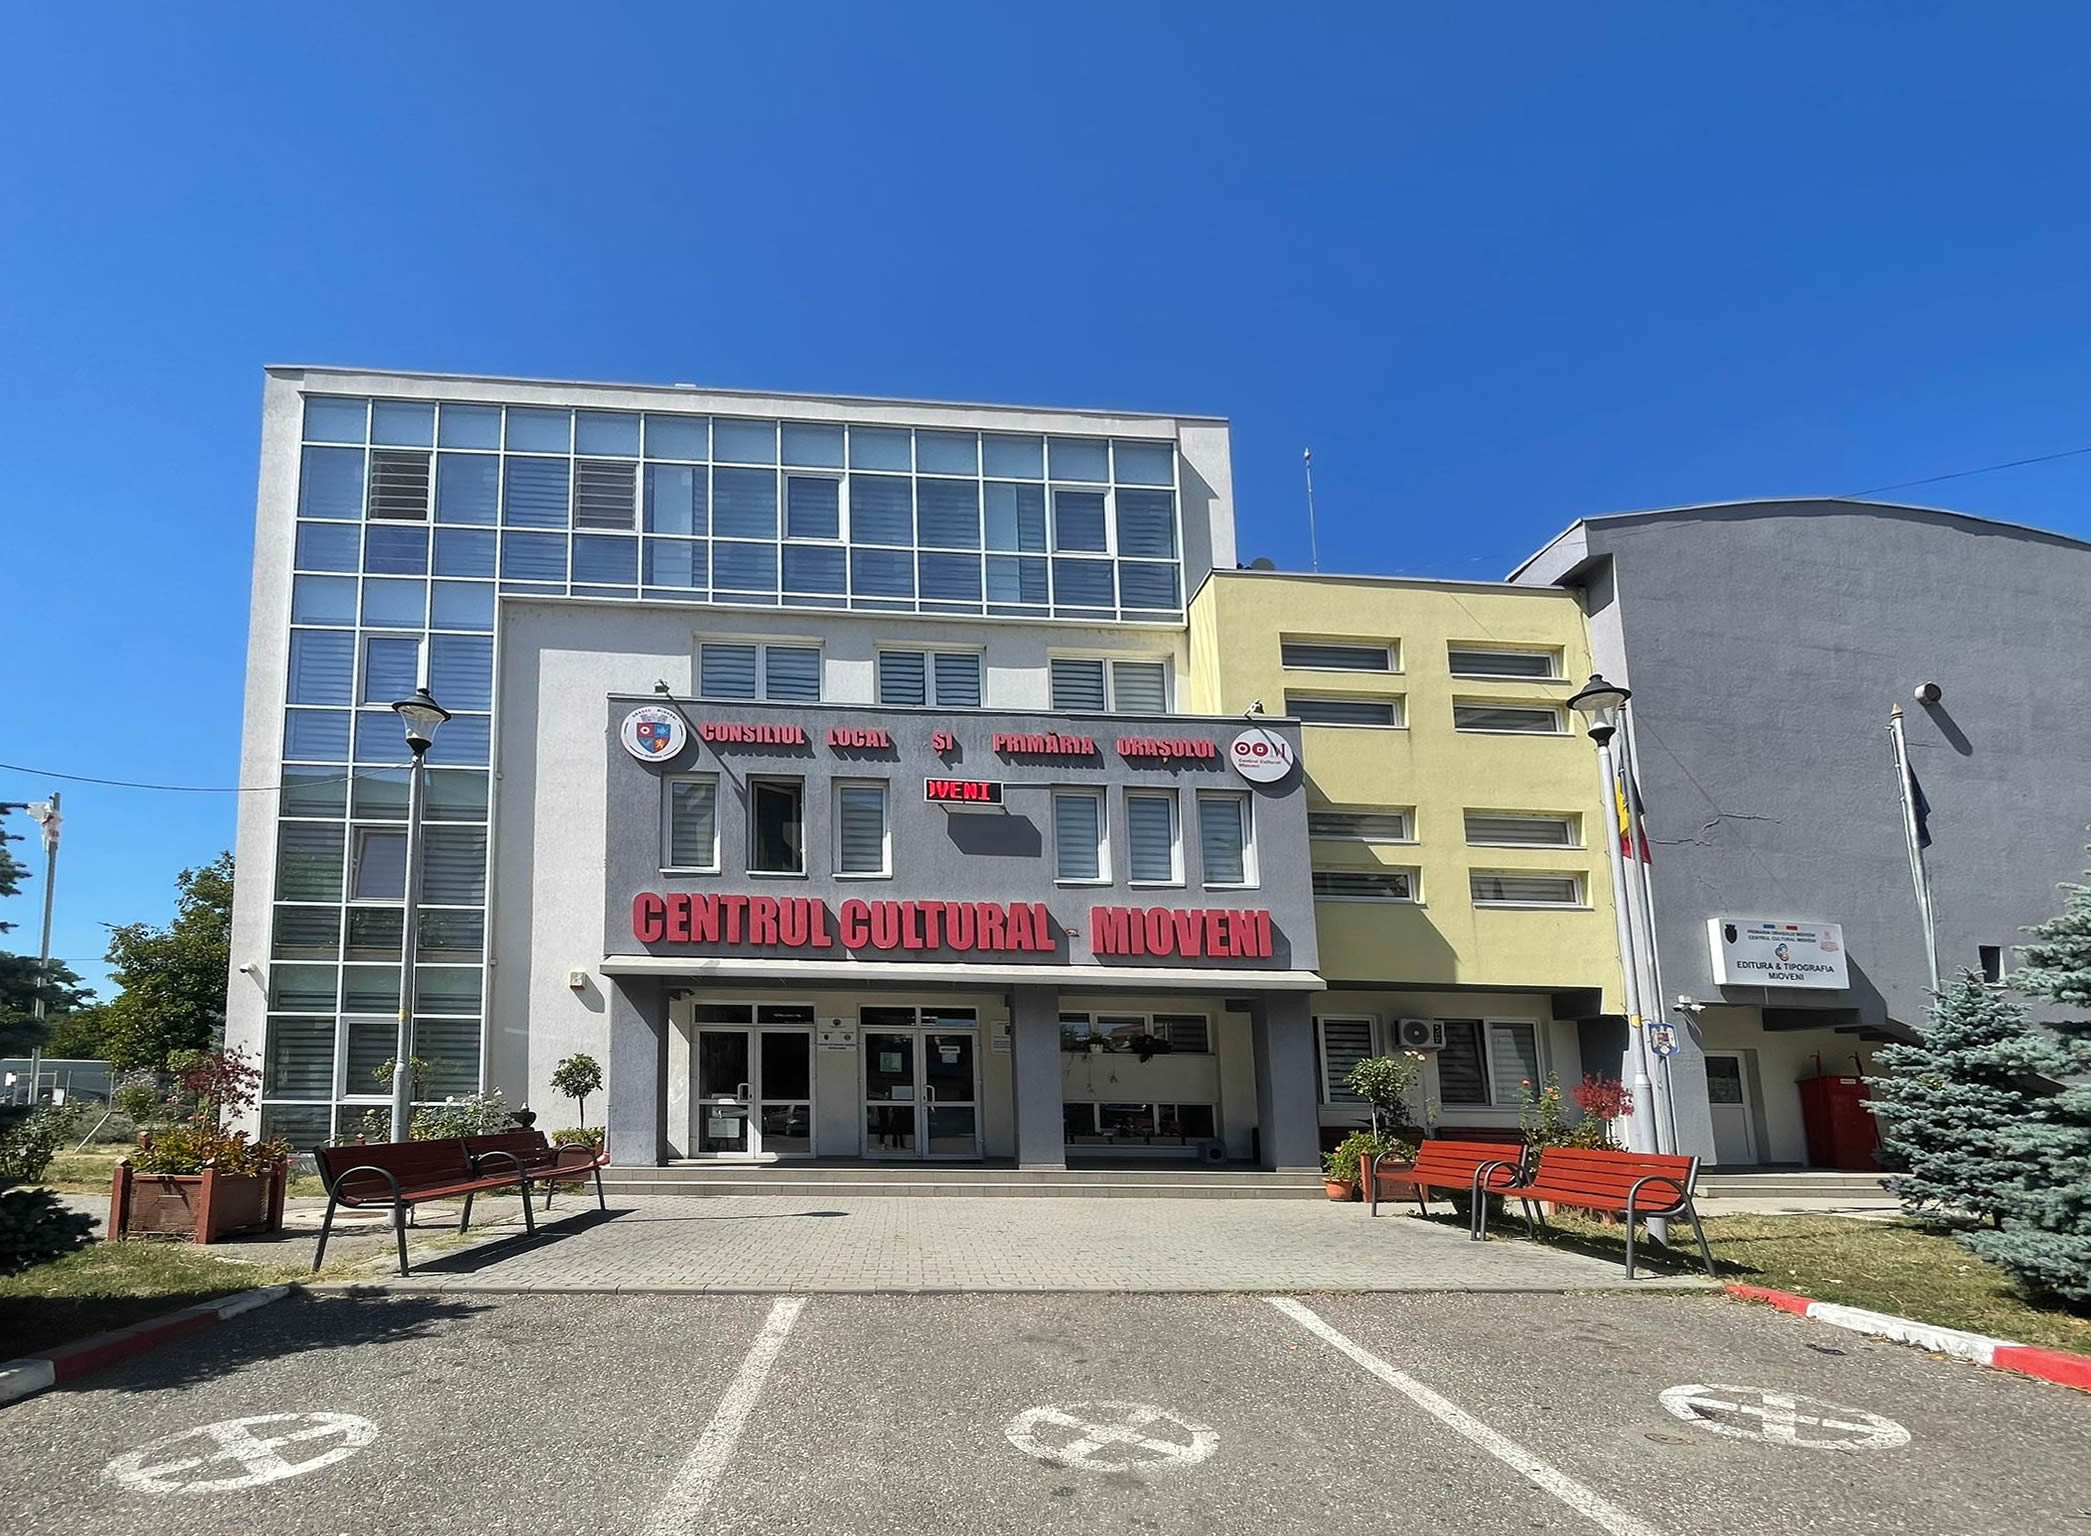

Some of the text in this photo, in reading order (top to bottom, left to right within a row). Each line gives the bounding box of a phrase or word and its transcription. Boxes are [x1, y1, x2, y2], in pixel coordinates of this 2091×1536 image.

[699, 722, 804, 745] CONSILIUL
[826, 727, 889, 748] LOCAL
[992, 731, 1095, 755] PRIMĂRIA
[632, 892, 1272, 958] CENTRUL CULTURAL MIOVENI
[1737, 961, 1835, 973] EDITURA & TIPOGRAFIA
